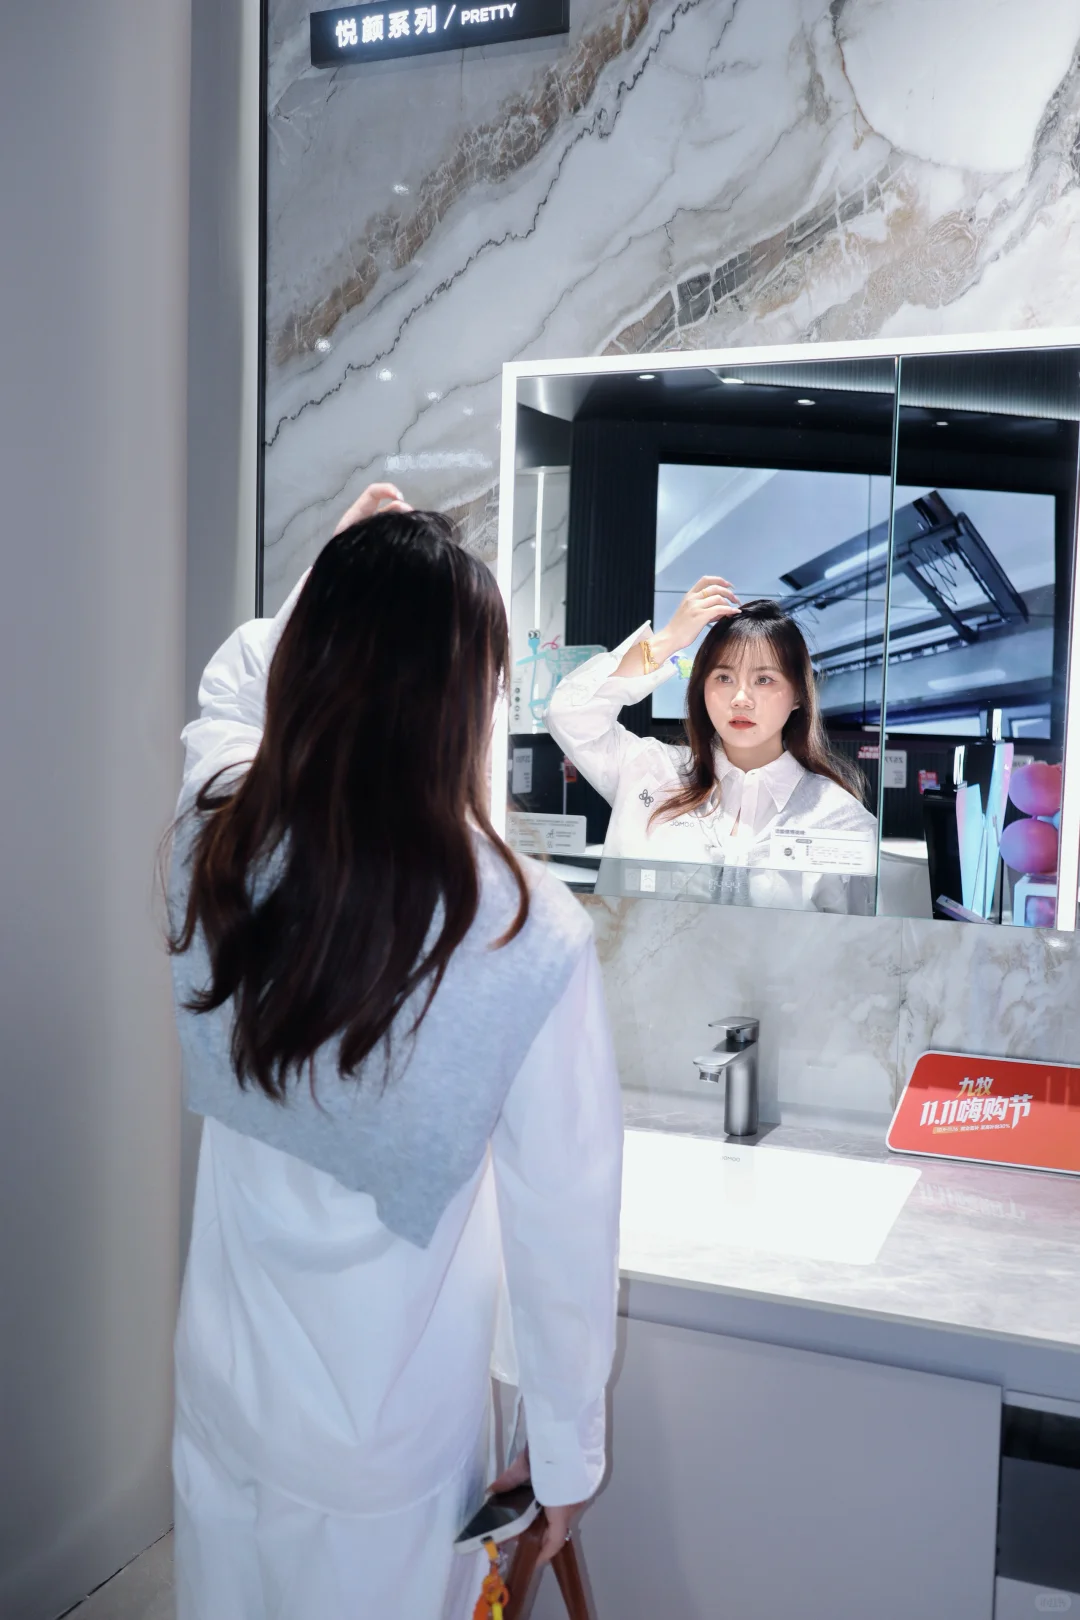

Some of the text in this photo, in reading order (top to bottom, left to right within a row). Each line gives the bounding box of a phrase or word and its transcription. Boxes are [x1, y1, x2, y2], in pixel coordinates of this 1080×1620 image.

[335, 5, 437, 48] 悦颜系列
[461, 3, 517, 25] PRETTY
[956, 1076, 994, 1099] 九牧
[920, 1093, 1034, 1130] 11.11嗨购节
